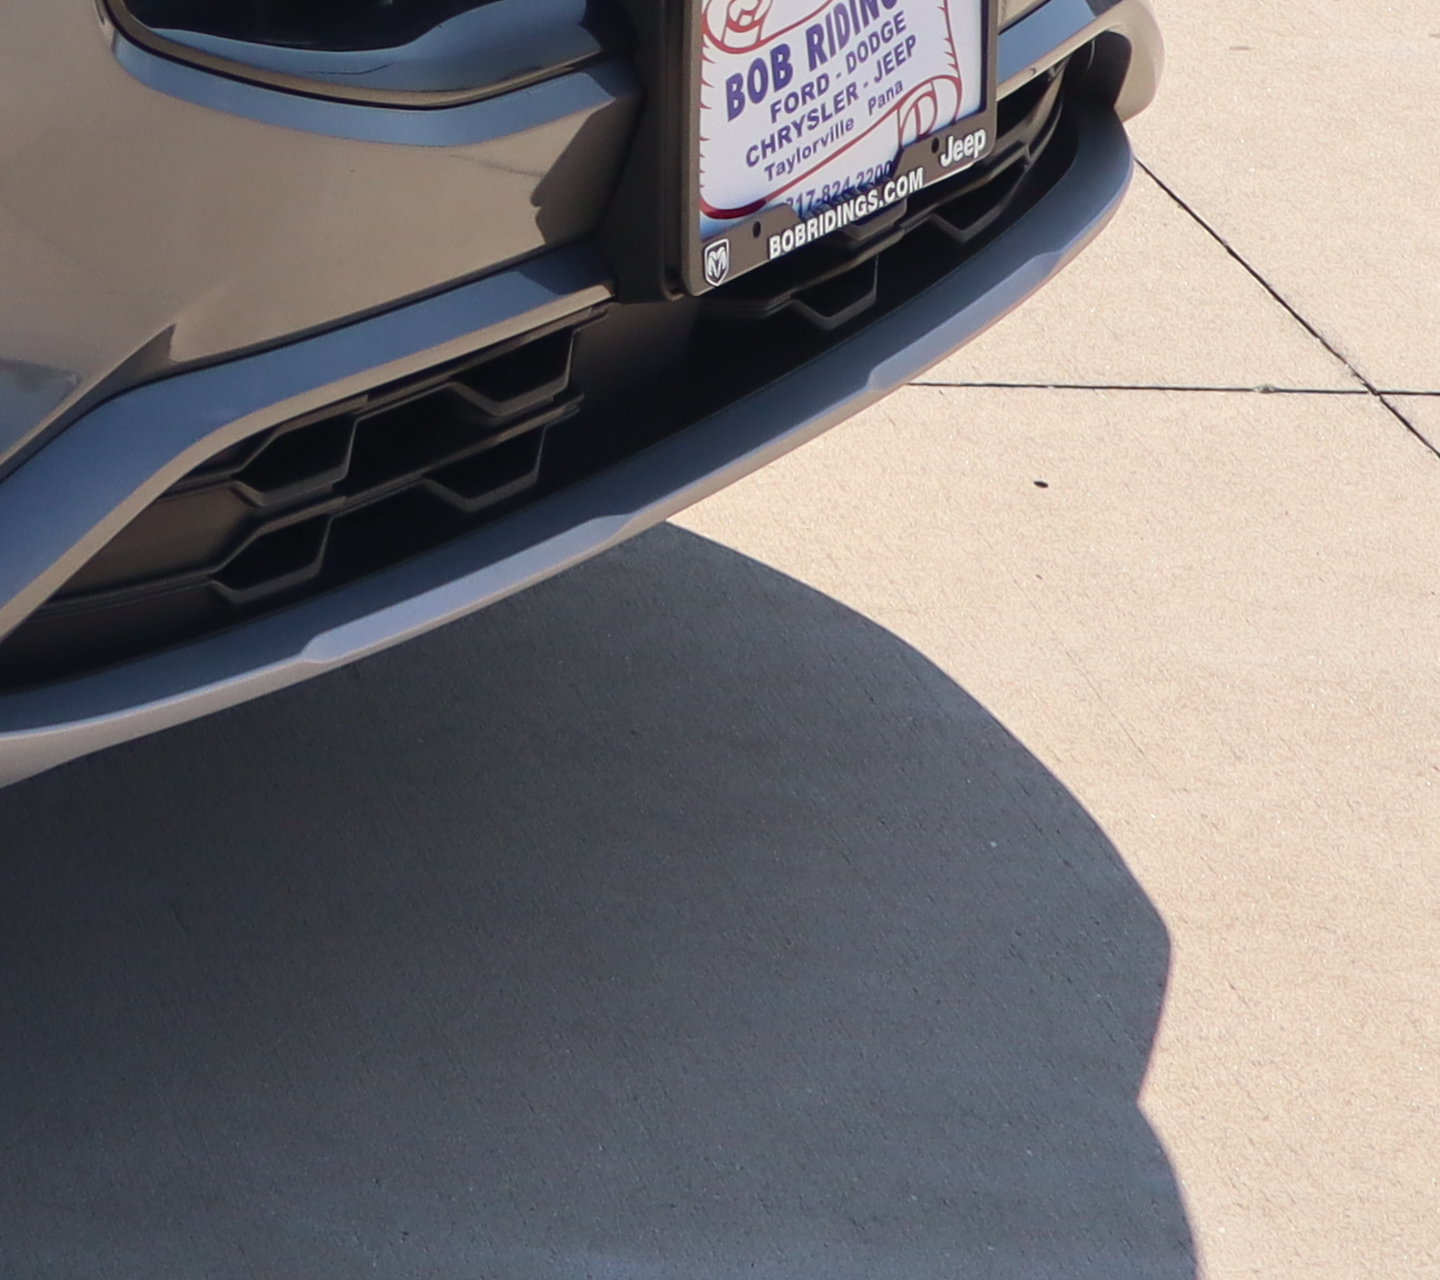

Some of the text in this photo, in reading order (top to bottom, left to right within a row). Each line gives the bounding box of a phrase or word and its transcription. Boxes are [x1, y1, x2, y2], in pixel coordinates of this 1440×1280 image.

[725, 43, 794, 123] BOB
[745, 82, 860, 168] CHRYSLER
[873, 34, 917, 83] JEEP
[770, 72, 830, 124] FORD
[845, 10, 907, 75] DODGE
[764, 80, 904, 182] Taylorville Pana
[940, 129, 987, 167] Jeep
[768, 167, 924, 260] BOBRIDINGS.COM
